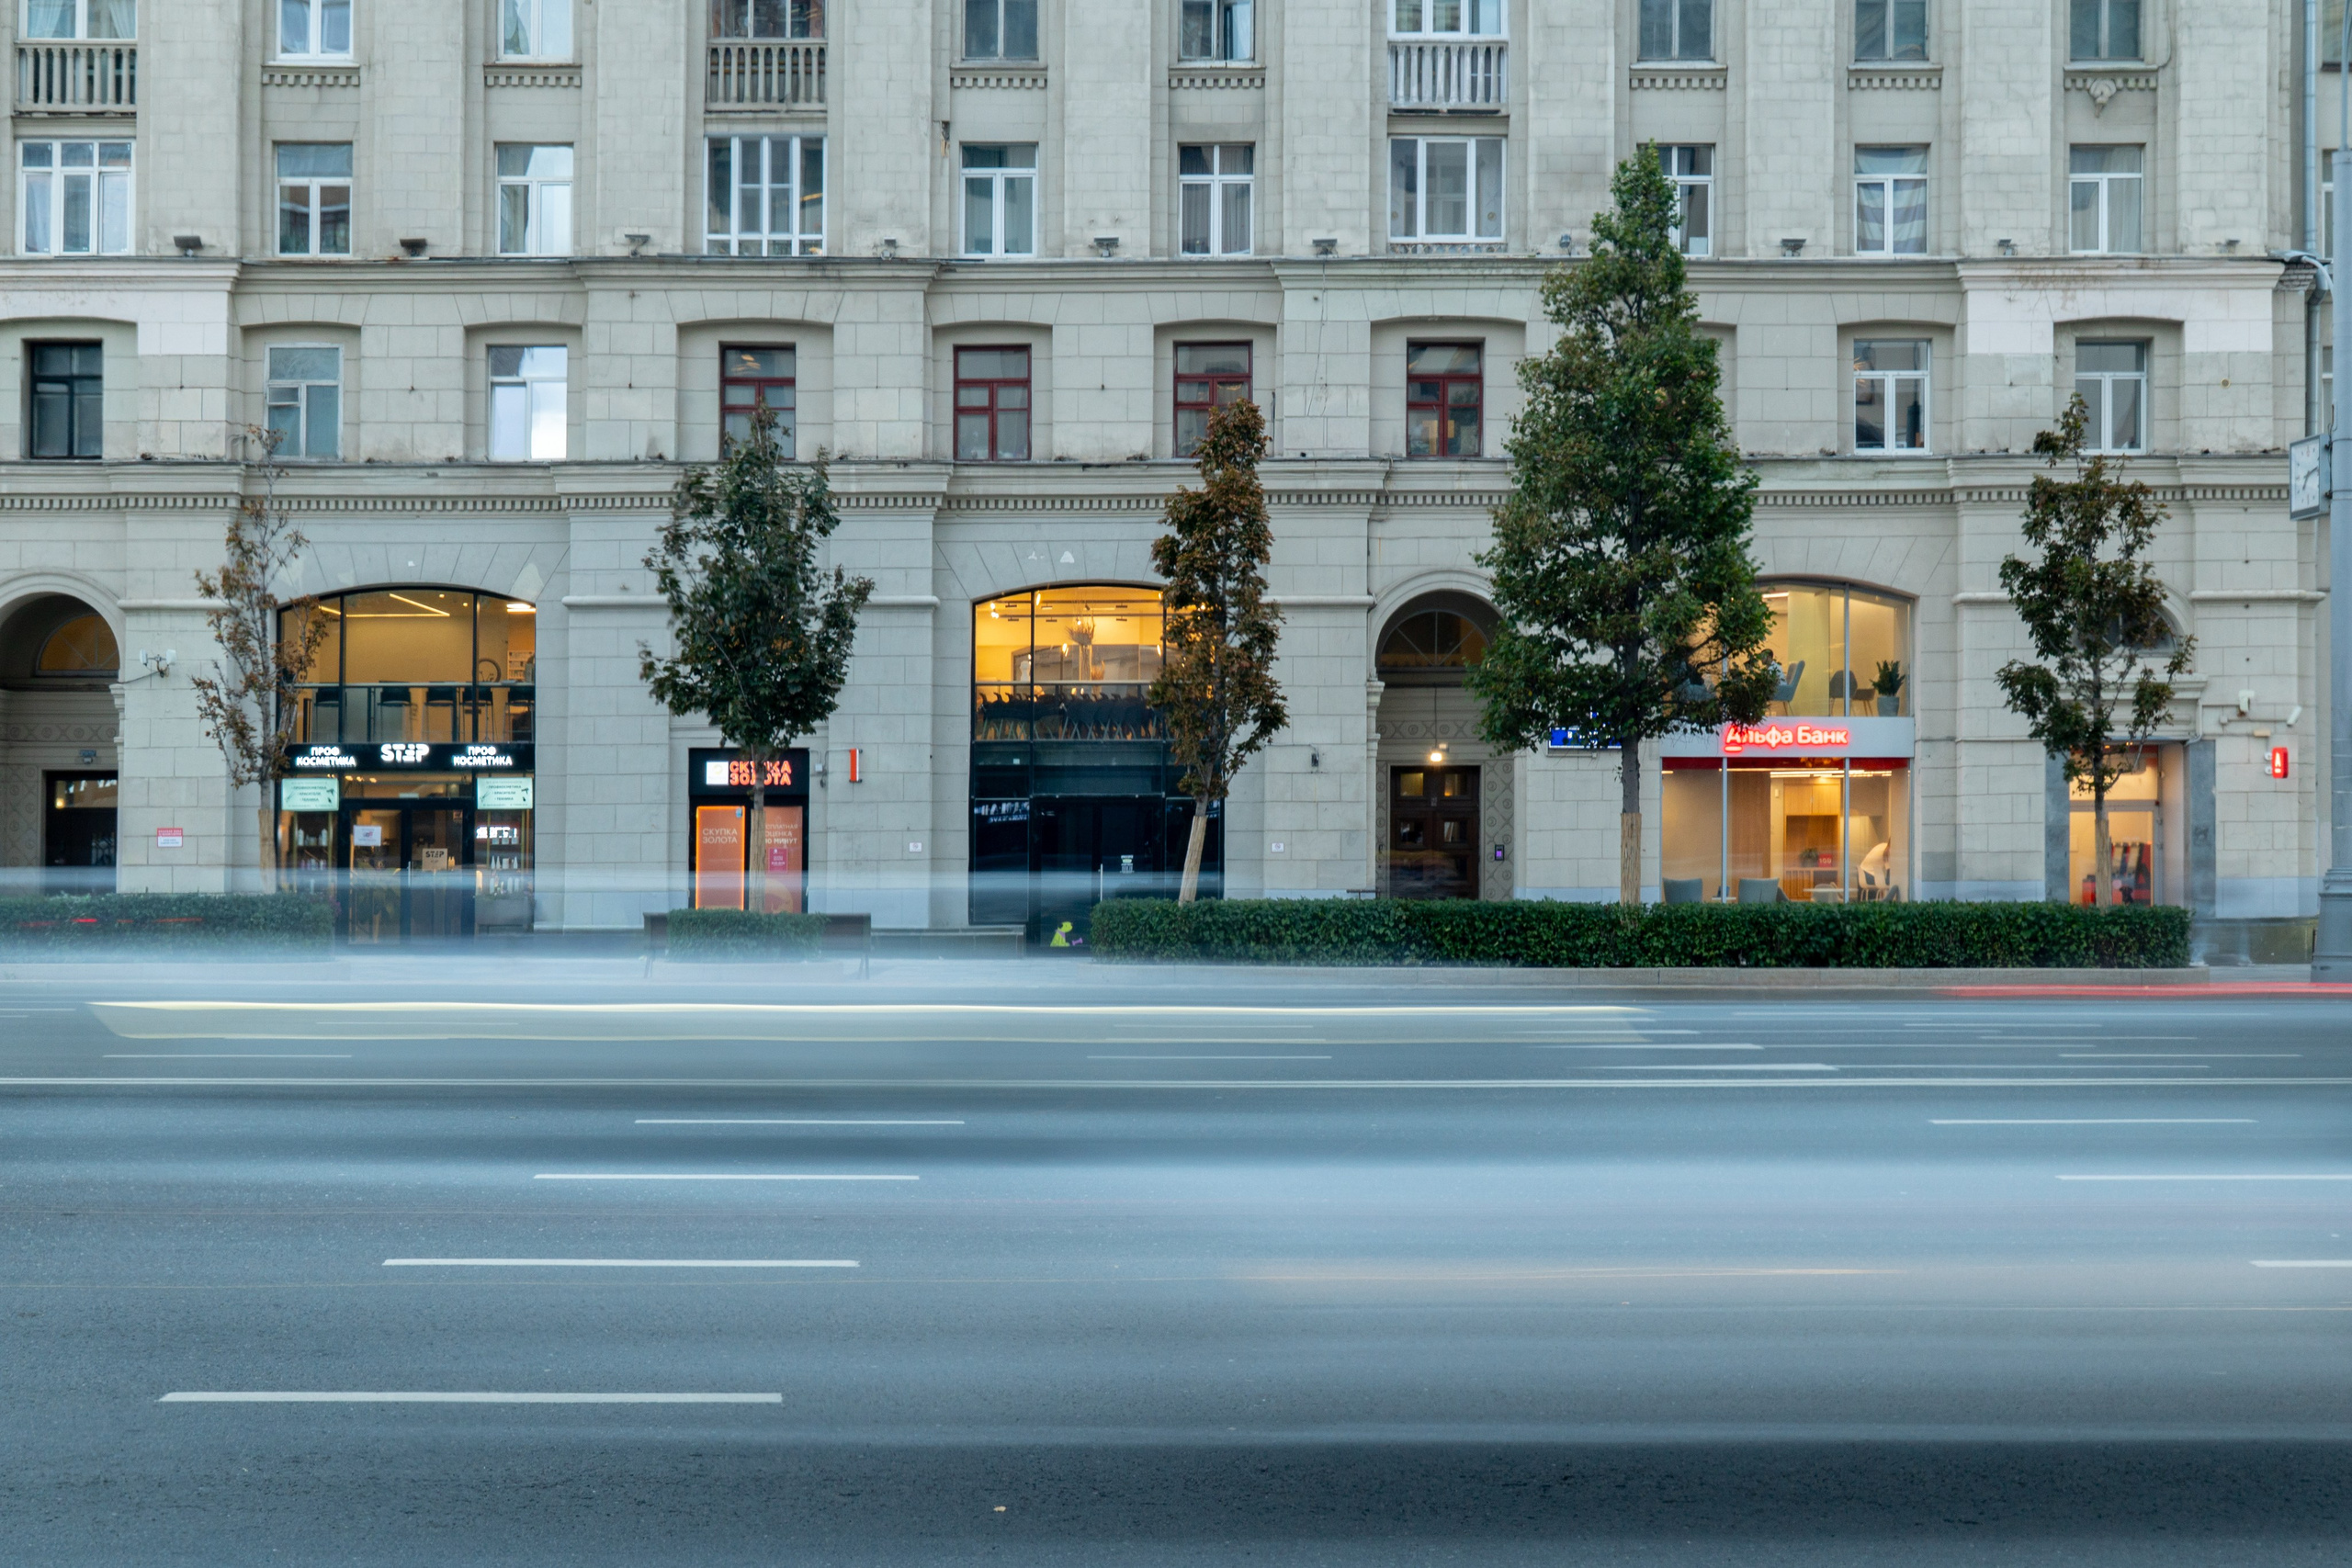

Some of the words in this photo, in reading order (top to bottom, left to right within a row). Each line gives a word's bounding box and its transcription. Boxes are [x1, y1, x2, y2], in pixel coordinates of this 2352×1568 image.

[1724, 725, 1793, 750] Альфа
[1797, 726, 1849, 745] Банк
[311, 746, 340, 756] ПРОФ
[380, 743, 430, 762] STEP
[468, 746, 497, 756] ПРОФ
[296, 756, 356, 767] КОСМЕТИКА
[453, 756, 513, 766] КОСМЕТИКА
[702, 828, 738, 836] СКУПКА
[702, 836, 738, 844] ЗОЛОТА
